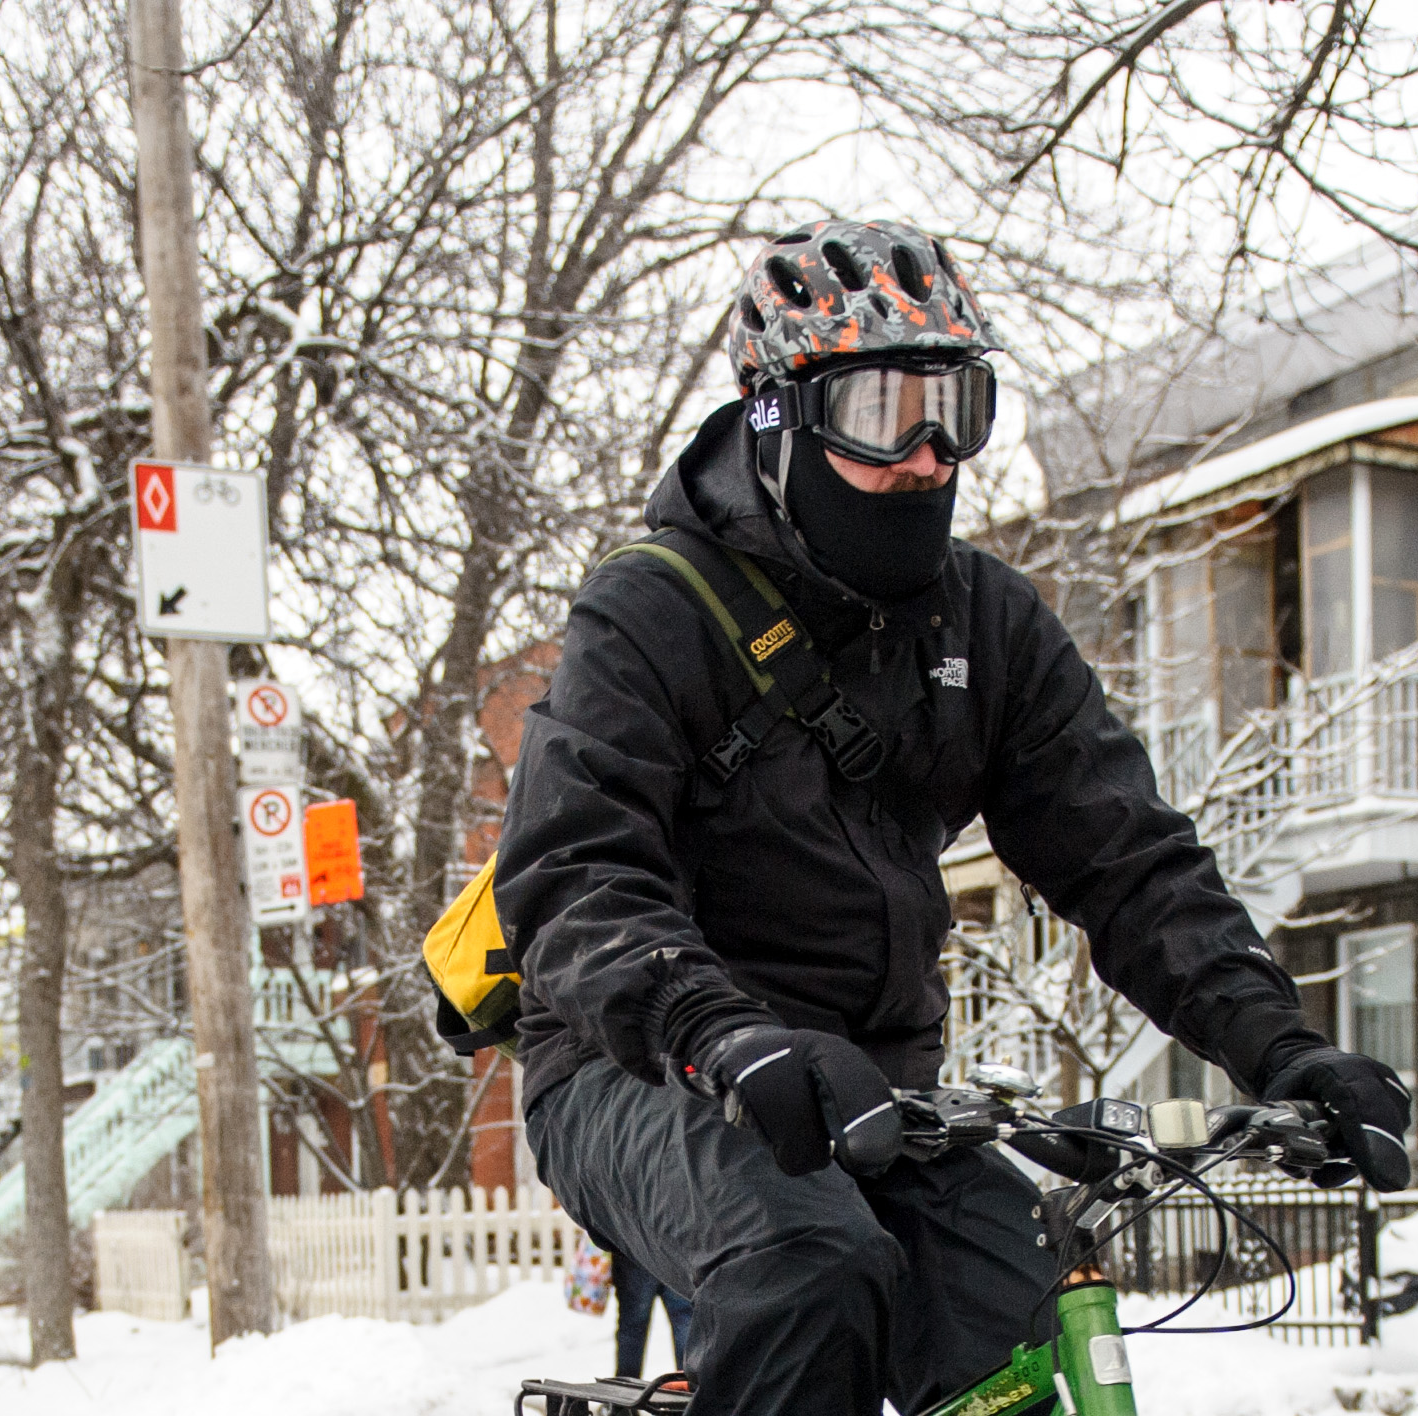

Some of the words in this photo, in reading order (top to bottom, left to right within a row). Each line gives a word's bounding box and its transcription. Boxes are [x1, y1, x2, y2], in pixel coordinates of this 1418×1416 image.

[749, 398, 780, 432] ollé
[750, 619, 793, 654] COCOTTE
[943, 657, 965, 669] THE
[929, 667, 966, 679] NORTH
[941, 677, 967, 689] FACE
